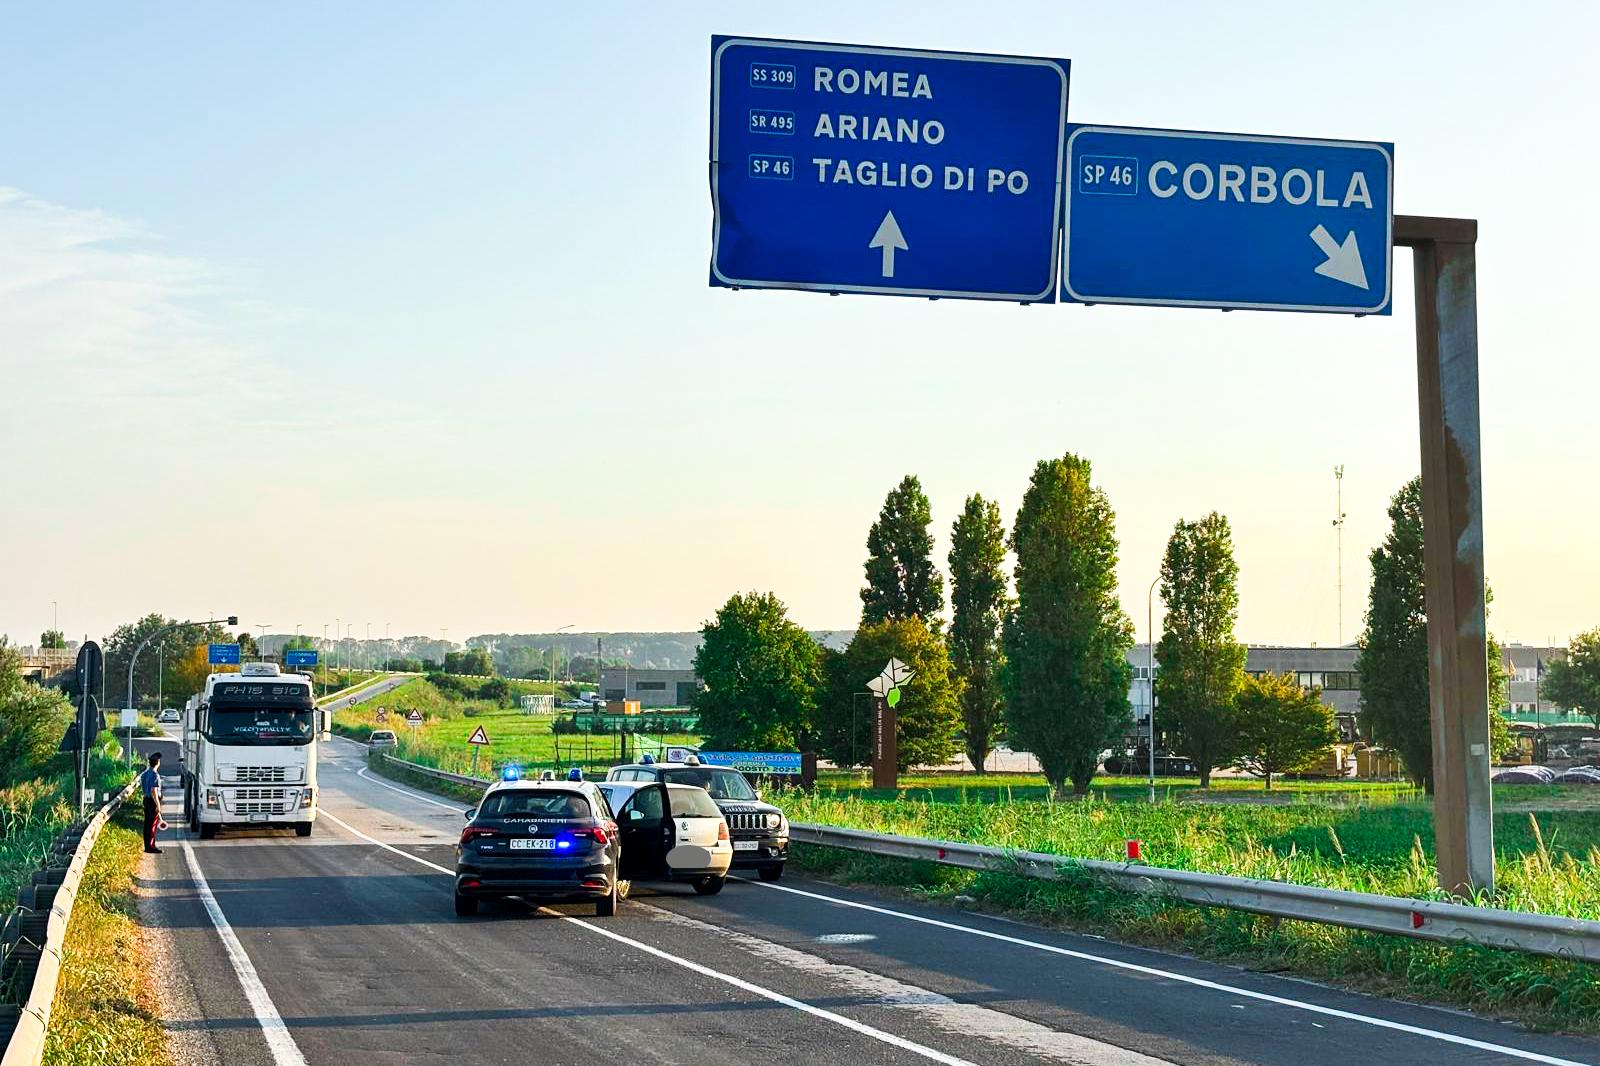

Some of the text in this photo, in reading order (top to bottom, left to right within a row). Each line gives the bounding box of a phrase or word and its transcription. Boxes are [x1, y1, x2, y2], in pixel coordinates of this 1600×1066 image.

[753, 69, 793, 83] SS 309
[814, 67, 932, 99] ROMEA
[752, 116, 793, 129] SR 495
[814, 114, 945, 145] ARIANO
[753, 160, 789, 175] SP 46
[813, 158, 1028, 194] TAGLIO DI PO
[1084, 165, 1132, 185] SP 46
[1148, 160, 1373, 209] CORBOLA
